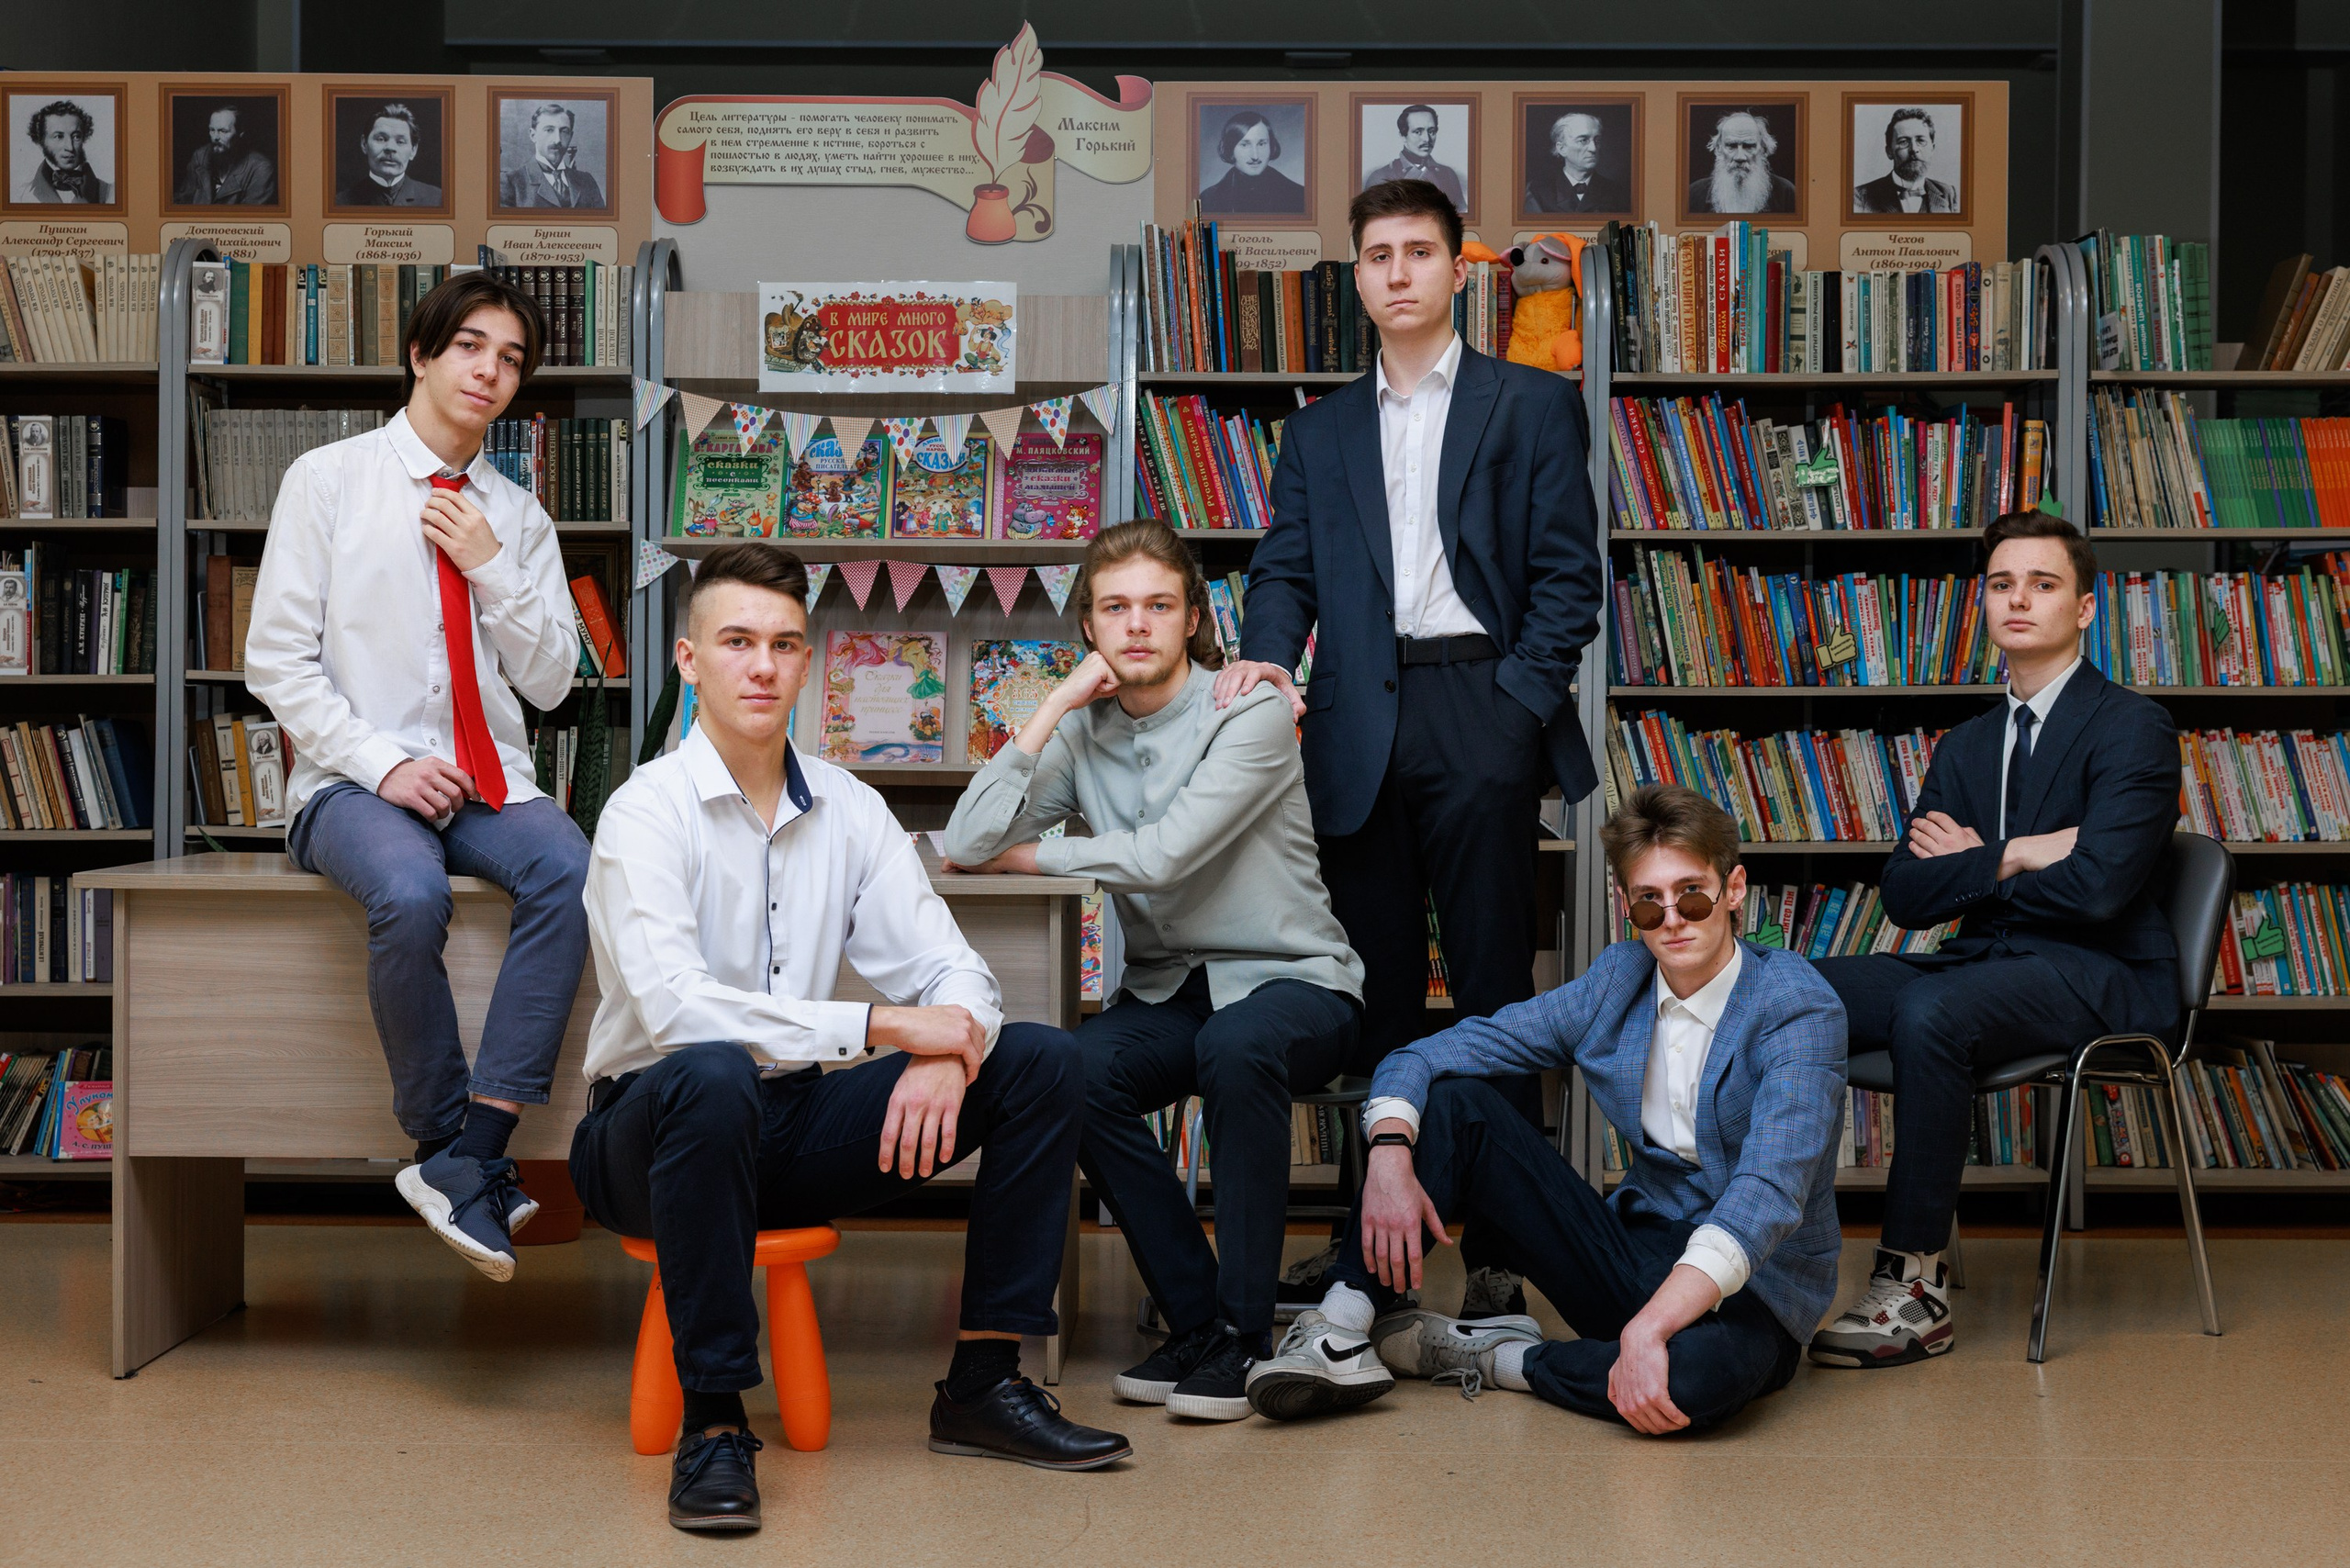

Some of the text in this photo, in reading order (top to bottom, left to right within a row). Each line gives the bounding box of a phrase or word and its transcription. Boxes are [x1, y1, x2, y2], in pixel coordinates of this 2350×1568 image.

[690, 111, 718, 122] Цель
[722, 114, 787, 125] литературы
[800, 114, 851, 123] помогать
[855, 114, 901, 126] человеку
[906, 115, 958, 124] понимать
[1058, 118, 1120, 130] Максим
[677, 125, 712, 134] самого
[716, 125, 744, 135] себя,
[747, 126, 792, 136] поднять
[796, 127, 814, 135] его
[818, 127, 842, 138] веру
[895, 128, 940, 138] развить
[711, 139, 926, 151] в нем стремление к истине, бороться с
[1076, 138, 1136, 154] Горький
[711, 151, 980, 164] пошлостью в людях, уметь найти хорошее в них,
[710, 164, 975, 177] возбуждать в их душах стыд, гнев, мужество...
[39, 224, 87, 236] Пушкин
[185, 225, 264, 237] Достоевский
[364, 227, 413, 238] Горький
[533, 229, 571, 240] Бунин
[1, 236, 125, 248] Александр Сергеевич
[364, 239, 412, 249] Максим
[1231, 234, 1273, 244] Гоголь
[1888, 234, 1925, 244] Чехов
[502, 240, 603, 251] Иван Алексеевич
[1245, 246, 1317, 256] Васильевич
[31, 248, 95, 259] (1799-1837)
[219, 249, 257, 259] 1-1881)
[355, 250, 422, 261] (1868-1936)
[520, 252, 586, 263] (1870-1953)
[1852, 247, 1960, 257] Антон Павлович
[1236, 259, 1287, 270] 09-1852)
[1870, 259, 1942, 271] (1860-1904)
[1683, 280, 1694, 314] КНИГА
[829, 311, 946, 326] В МИРЕ МНОГО
[2135, 283, 2148, 360] Геннадий ЦЫФЕРОВ
[828, 330, 947, 360] СКАЗОК
[1684, 317, 1695, 361] ЗОЛОТАЯ
[706, 442, 773, 453] КАРГАОВА
[1028, 446, 1091, 455] ПЛЯЦКОВСКИЙ
[707, 461, 759, 469] сказки
[1187, 420, 1215, 507] РУССКИЕ СКАЗКИ
[578, 622, 593, 645] МУМУ
[865, 670, 902, 684] Сказки
[1012, 688, 1038, 699] 365
